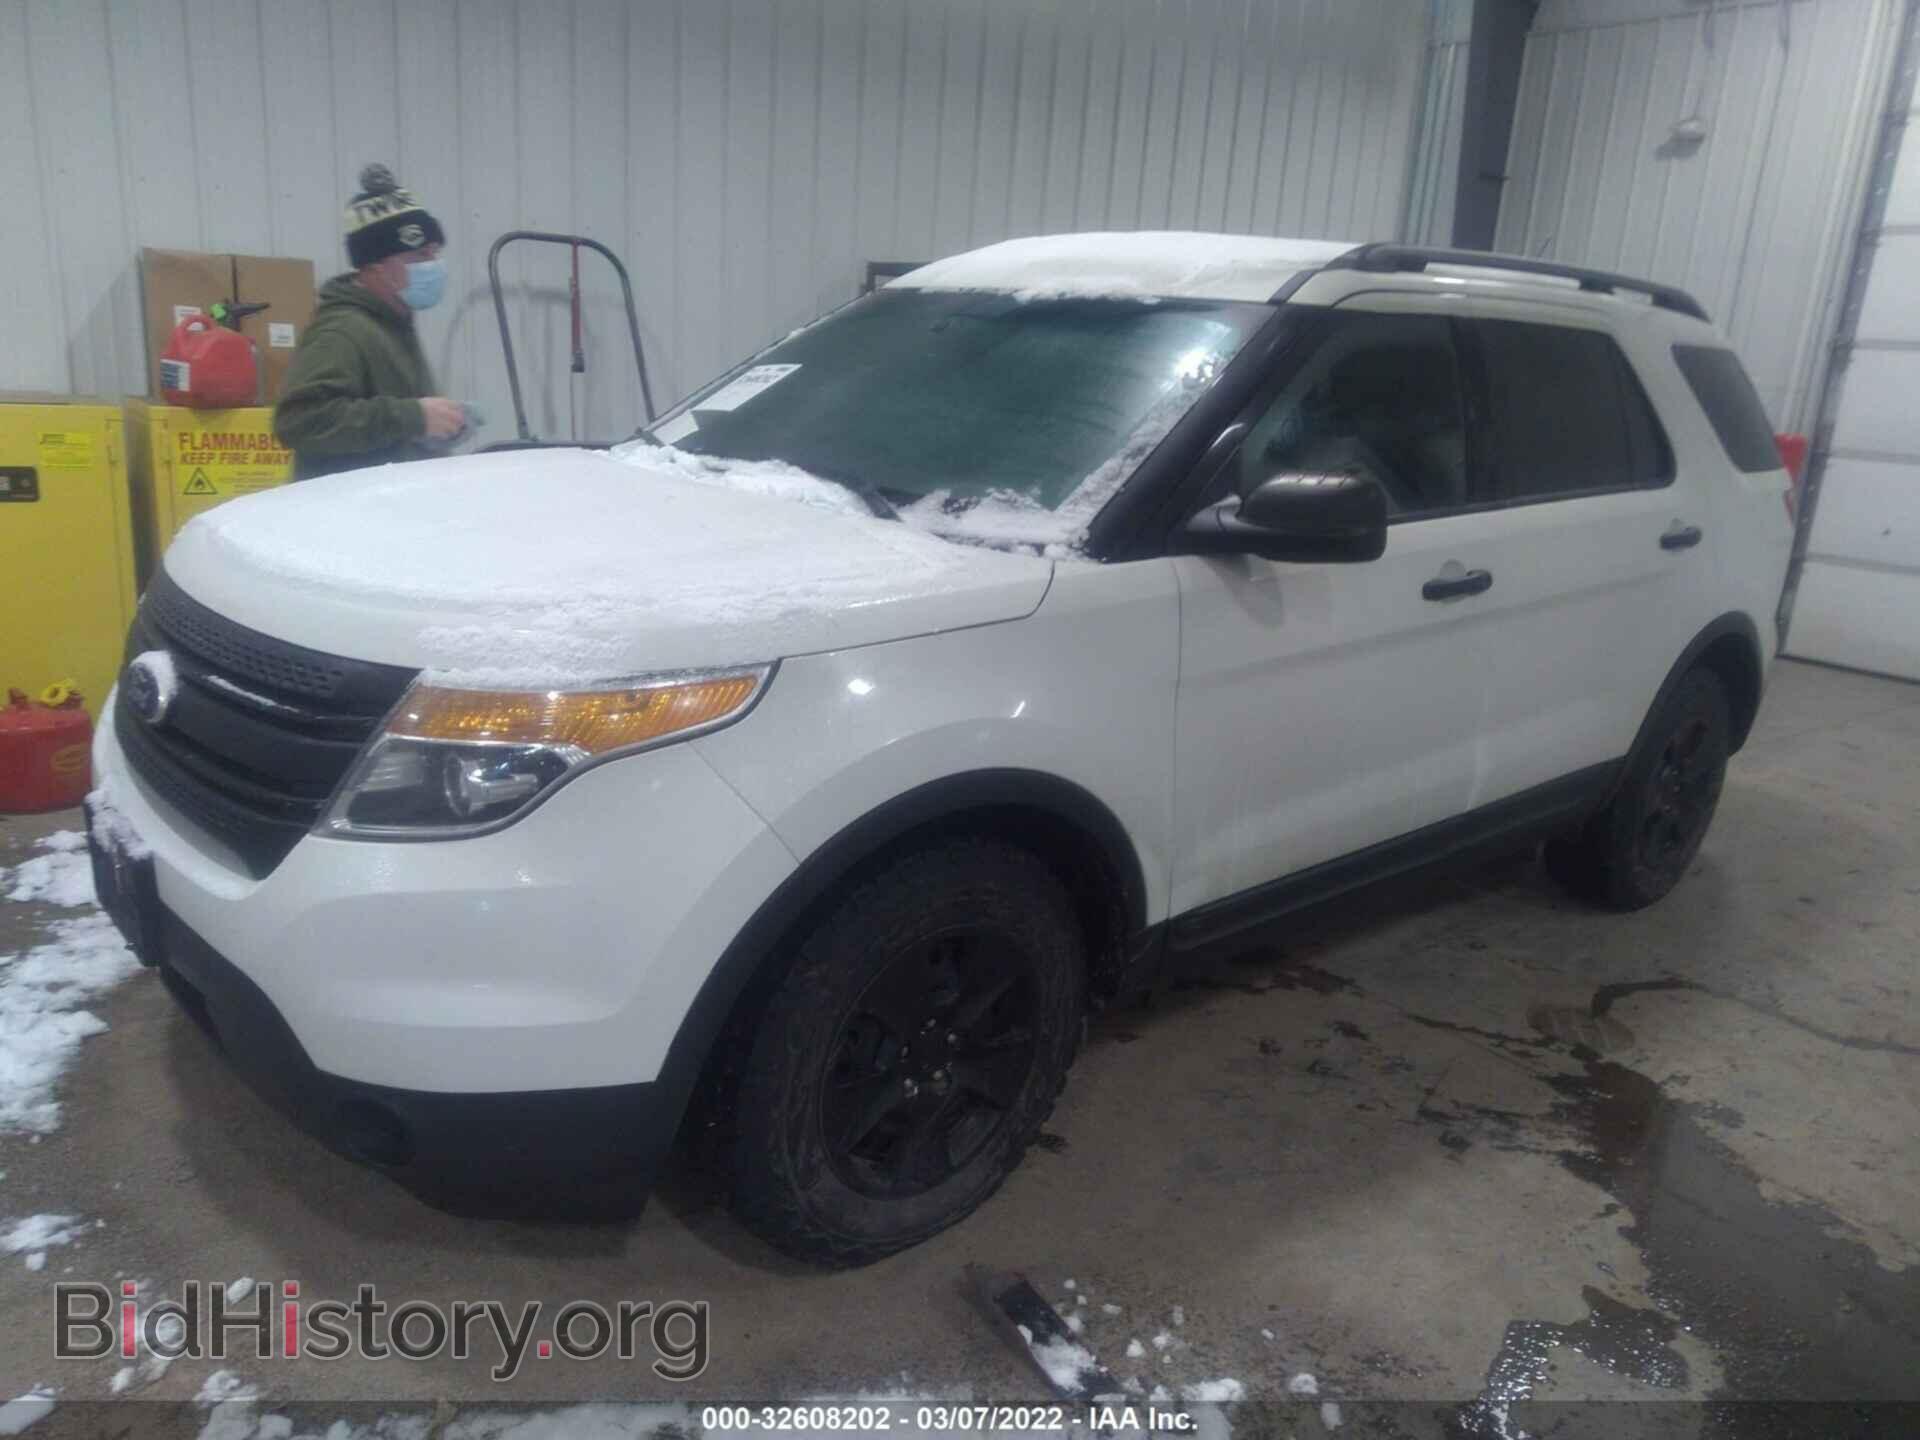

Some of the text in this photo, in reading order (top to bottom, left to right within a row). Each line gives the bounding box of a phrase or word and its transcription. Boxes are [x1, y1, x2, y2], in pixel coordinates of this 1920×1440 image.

[181, 453, 291, 465] KEEP FIRE AWAY
